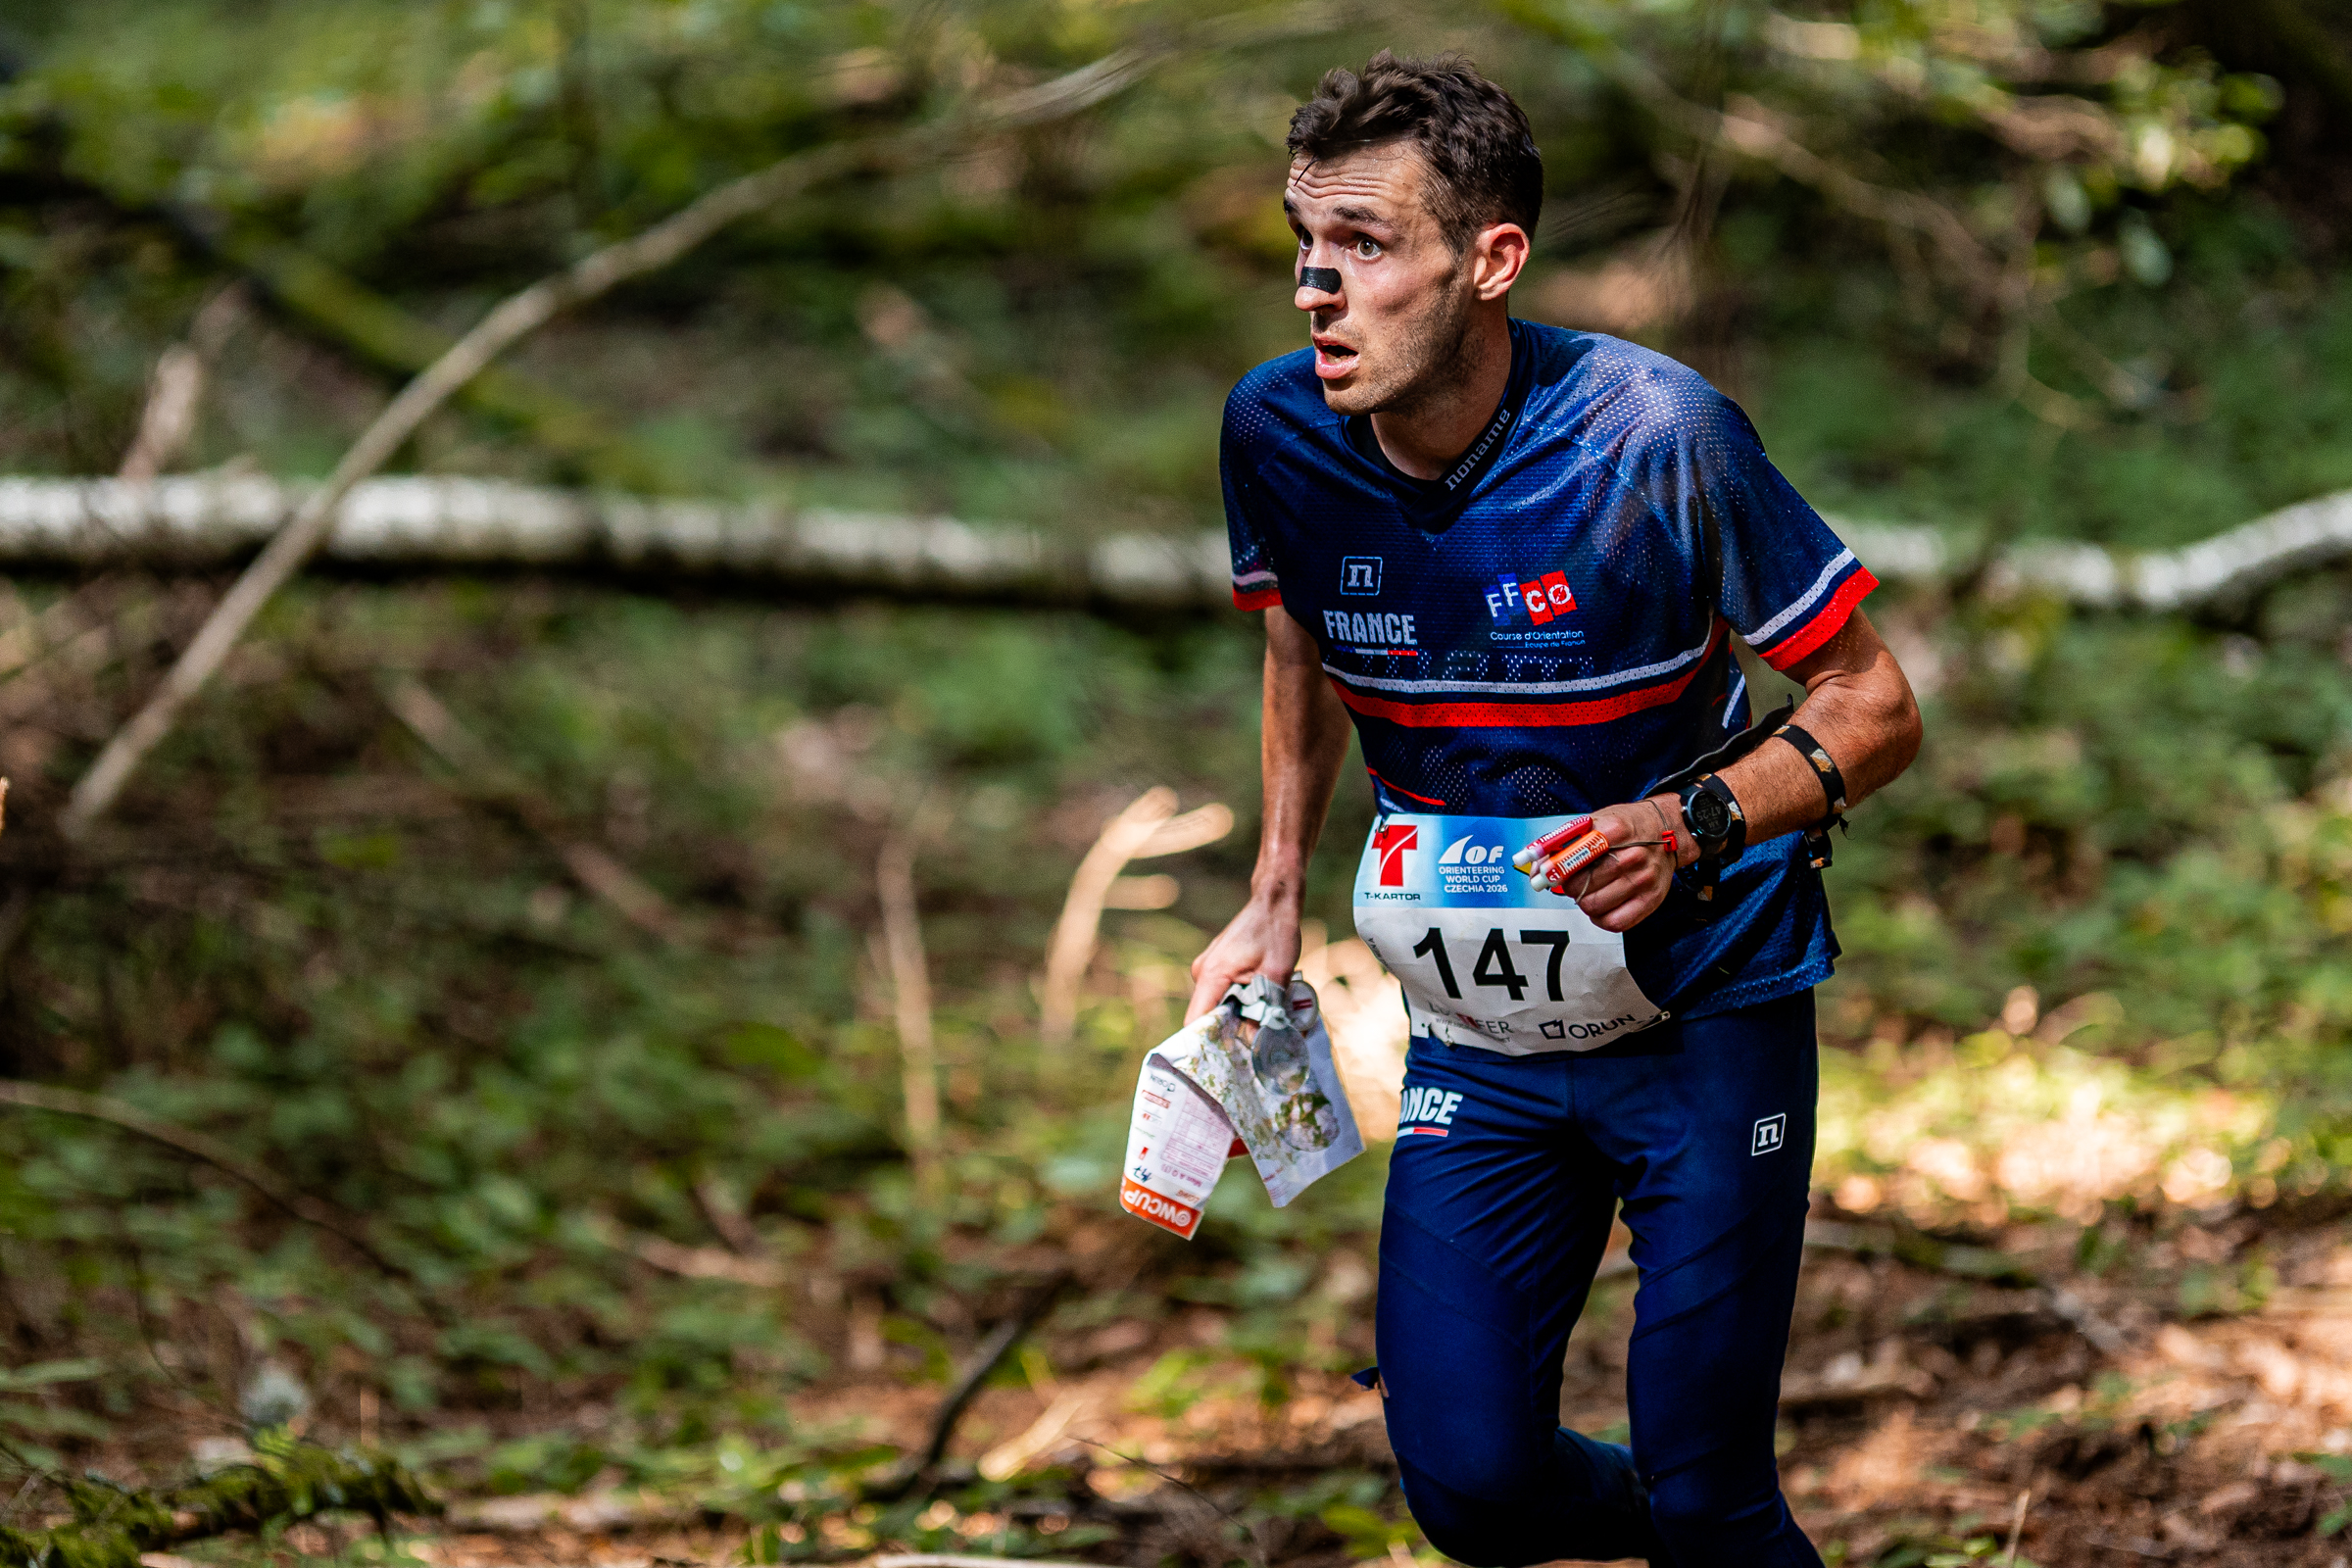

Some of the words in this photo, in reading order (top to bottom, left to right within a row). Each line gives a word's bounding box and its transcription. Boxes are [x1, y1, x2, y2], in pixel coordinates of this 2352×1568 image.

[1445, 409, 1510, 491] noname
[1323, 610, 1418, 645] FRANCE
[1490, 631, 1523, 641] Course
[1439, 866, 1505, 875] ORIENTEERING
[1446, 875, 1480, 884] WORLD
[1444, 884, 1486, 893] CZECHIA
[1487, 884, 1508, 893] 2026
[1364, 892, 1421, 901] T-KARTOR
[1413, 926, 1571, 1002] 147
[1568, 1013, 1637, 1040] ORUN
